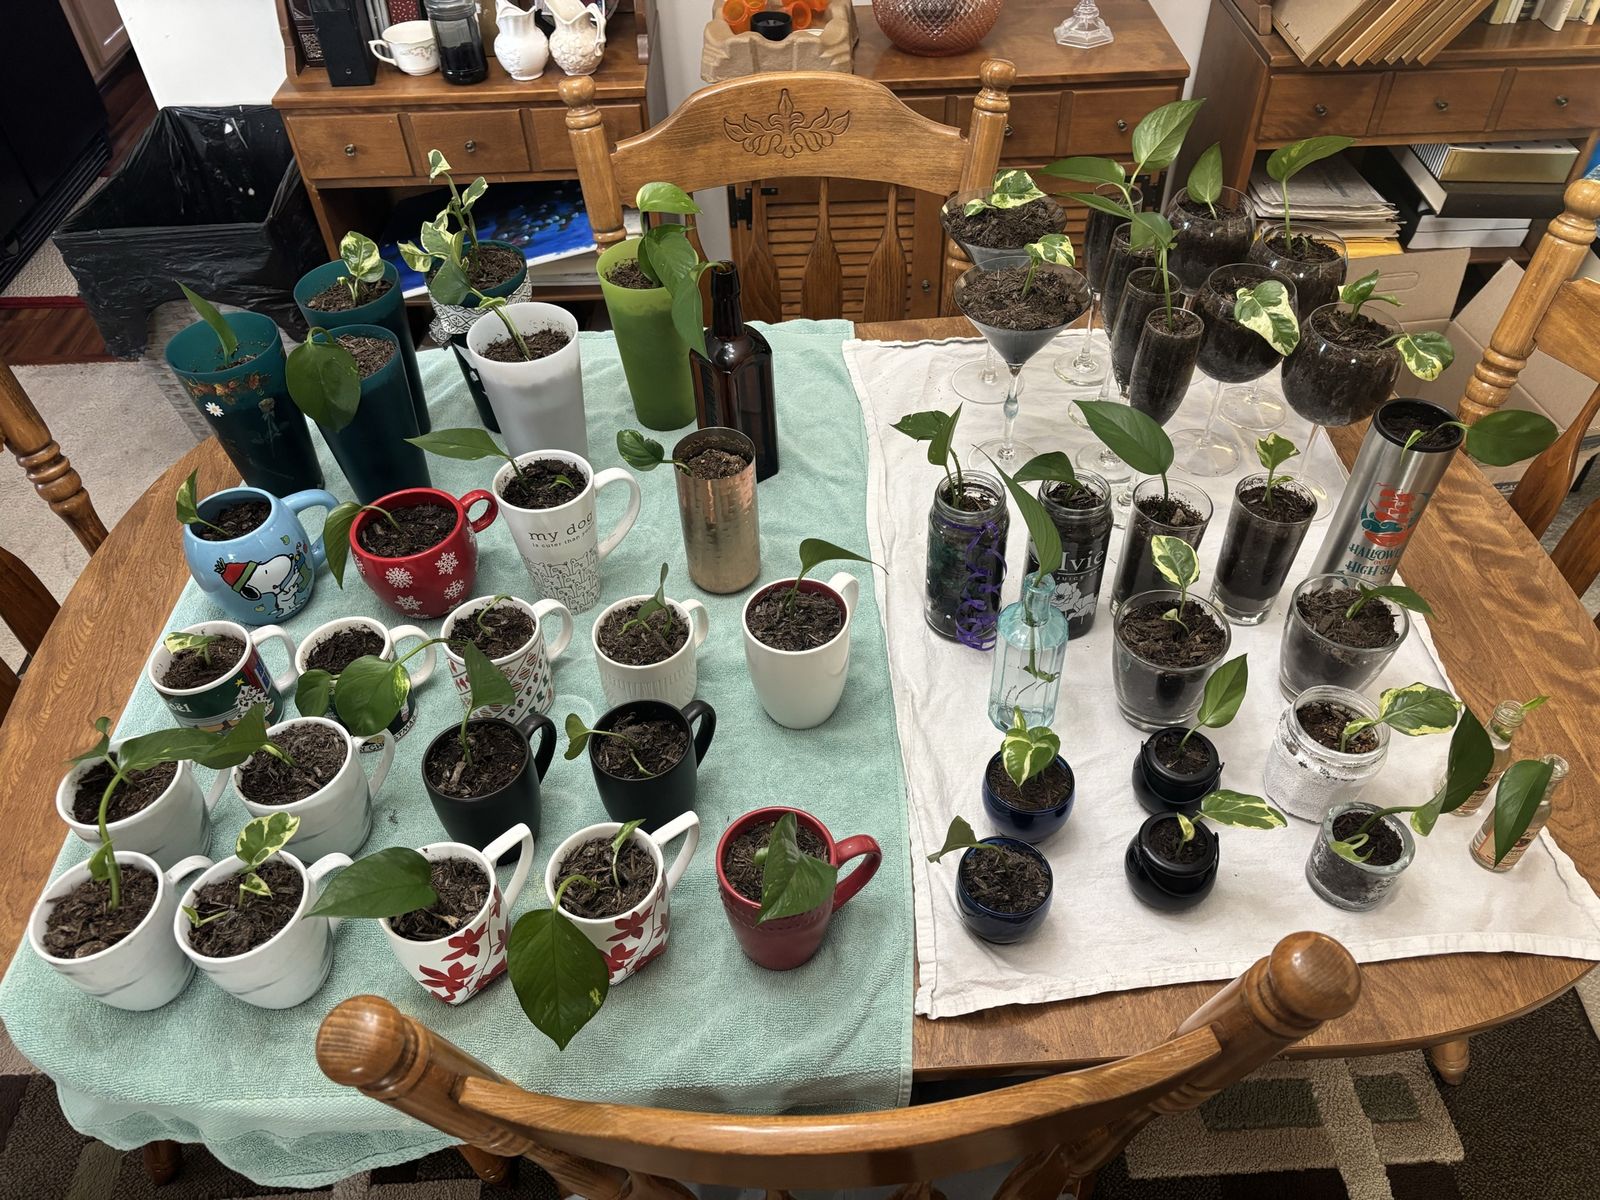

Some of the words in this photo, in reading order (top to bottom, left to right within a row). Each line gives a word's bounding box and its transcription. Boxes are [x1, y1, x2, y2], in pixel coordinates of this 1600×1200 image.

[528, 531, 559, 543] my
[566, 511, 593, 536] dog
[564, 535, 581, 545] than
[1345, 560, 1379, 577] HIGH
